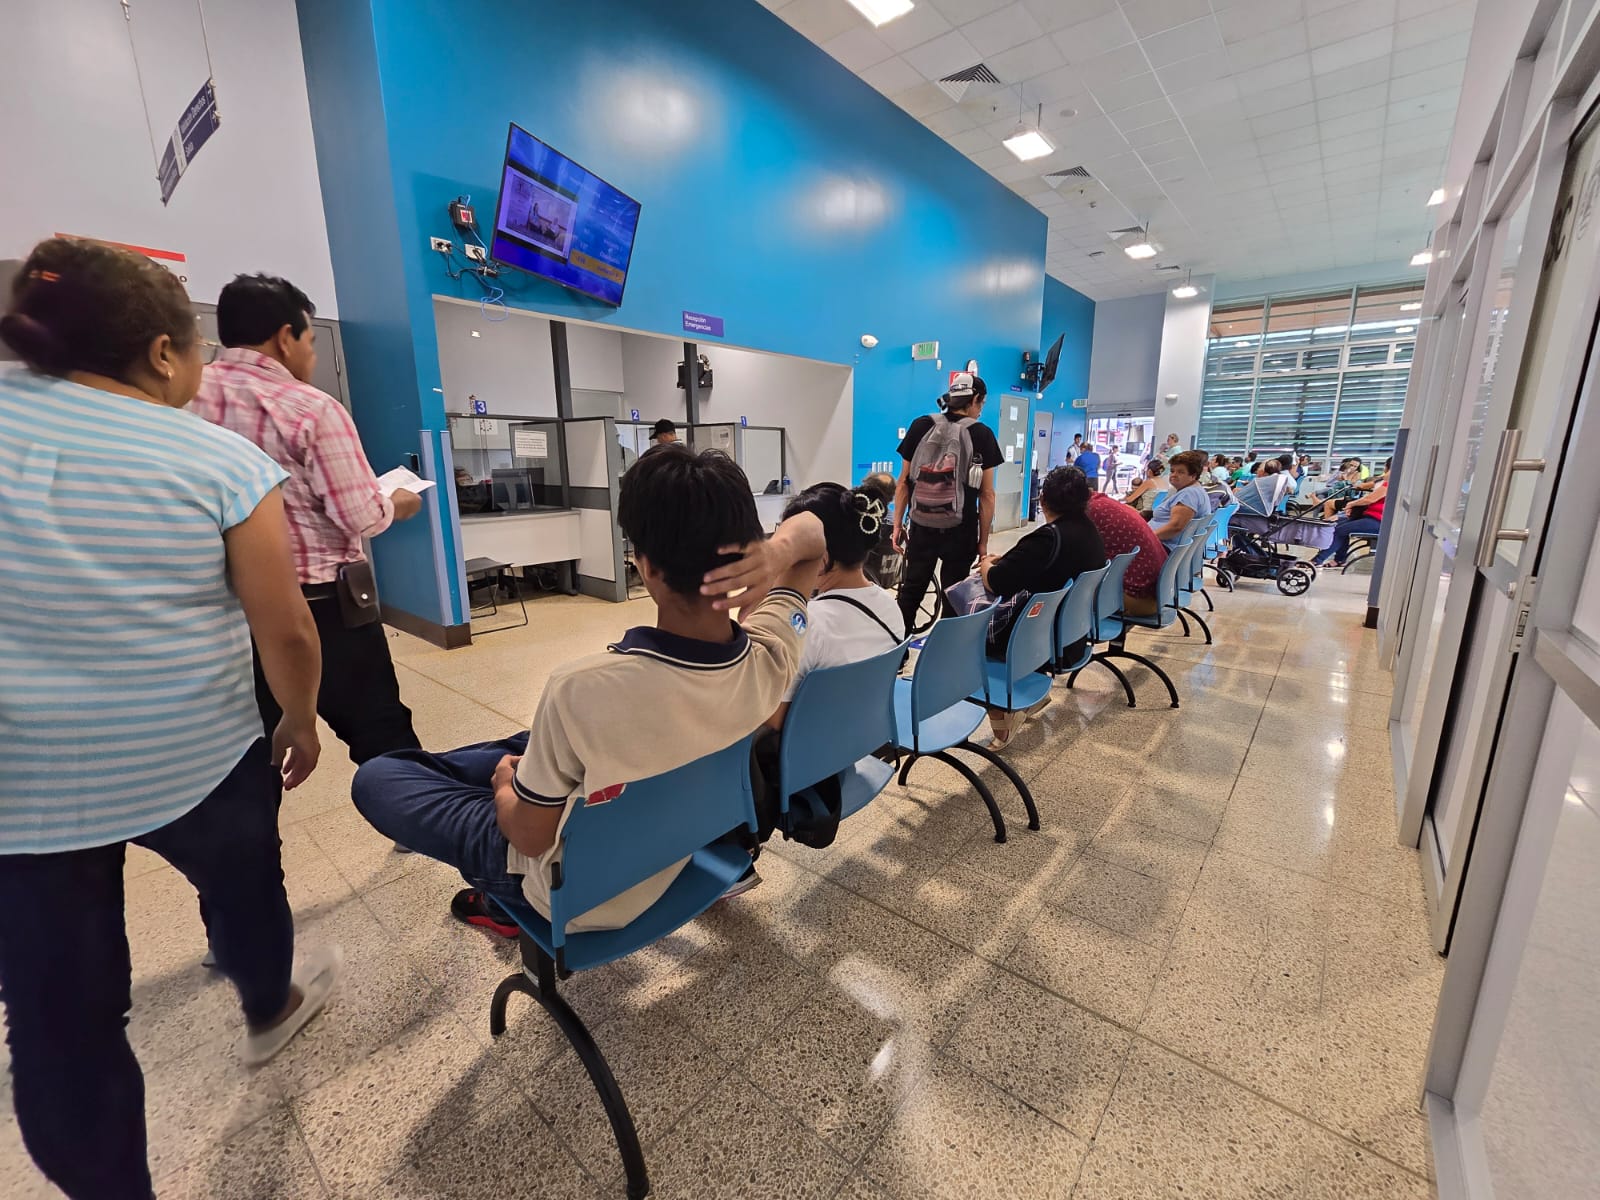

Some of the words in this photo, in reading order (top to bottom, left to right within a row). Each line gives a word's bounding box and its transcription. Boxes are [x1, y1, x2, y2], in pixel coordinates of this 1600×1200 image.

[684, 320, 712, 331] Emergencias
[477, 401, 486, 413] 3
[632, 410, 638, 420] 2
